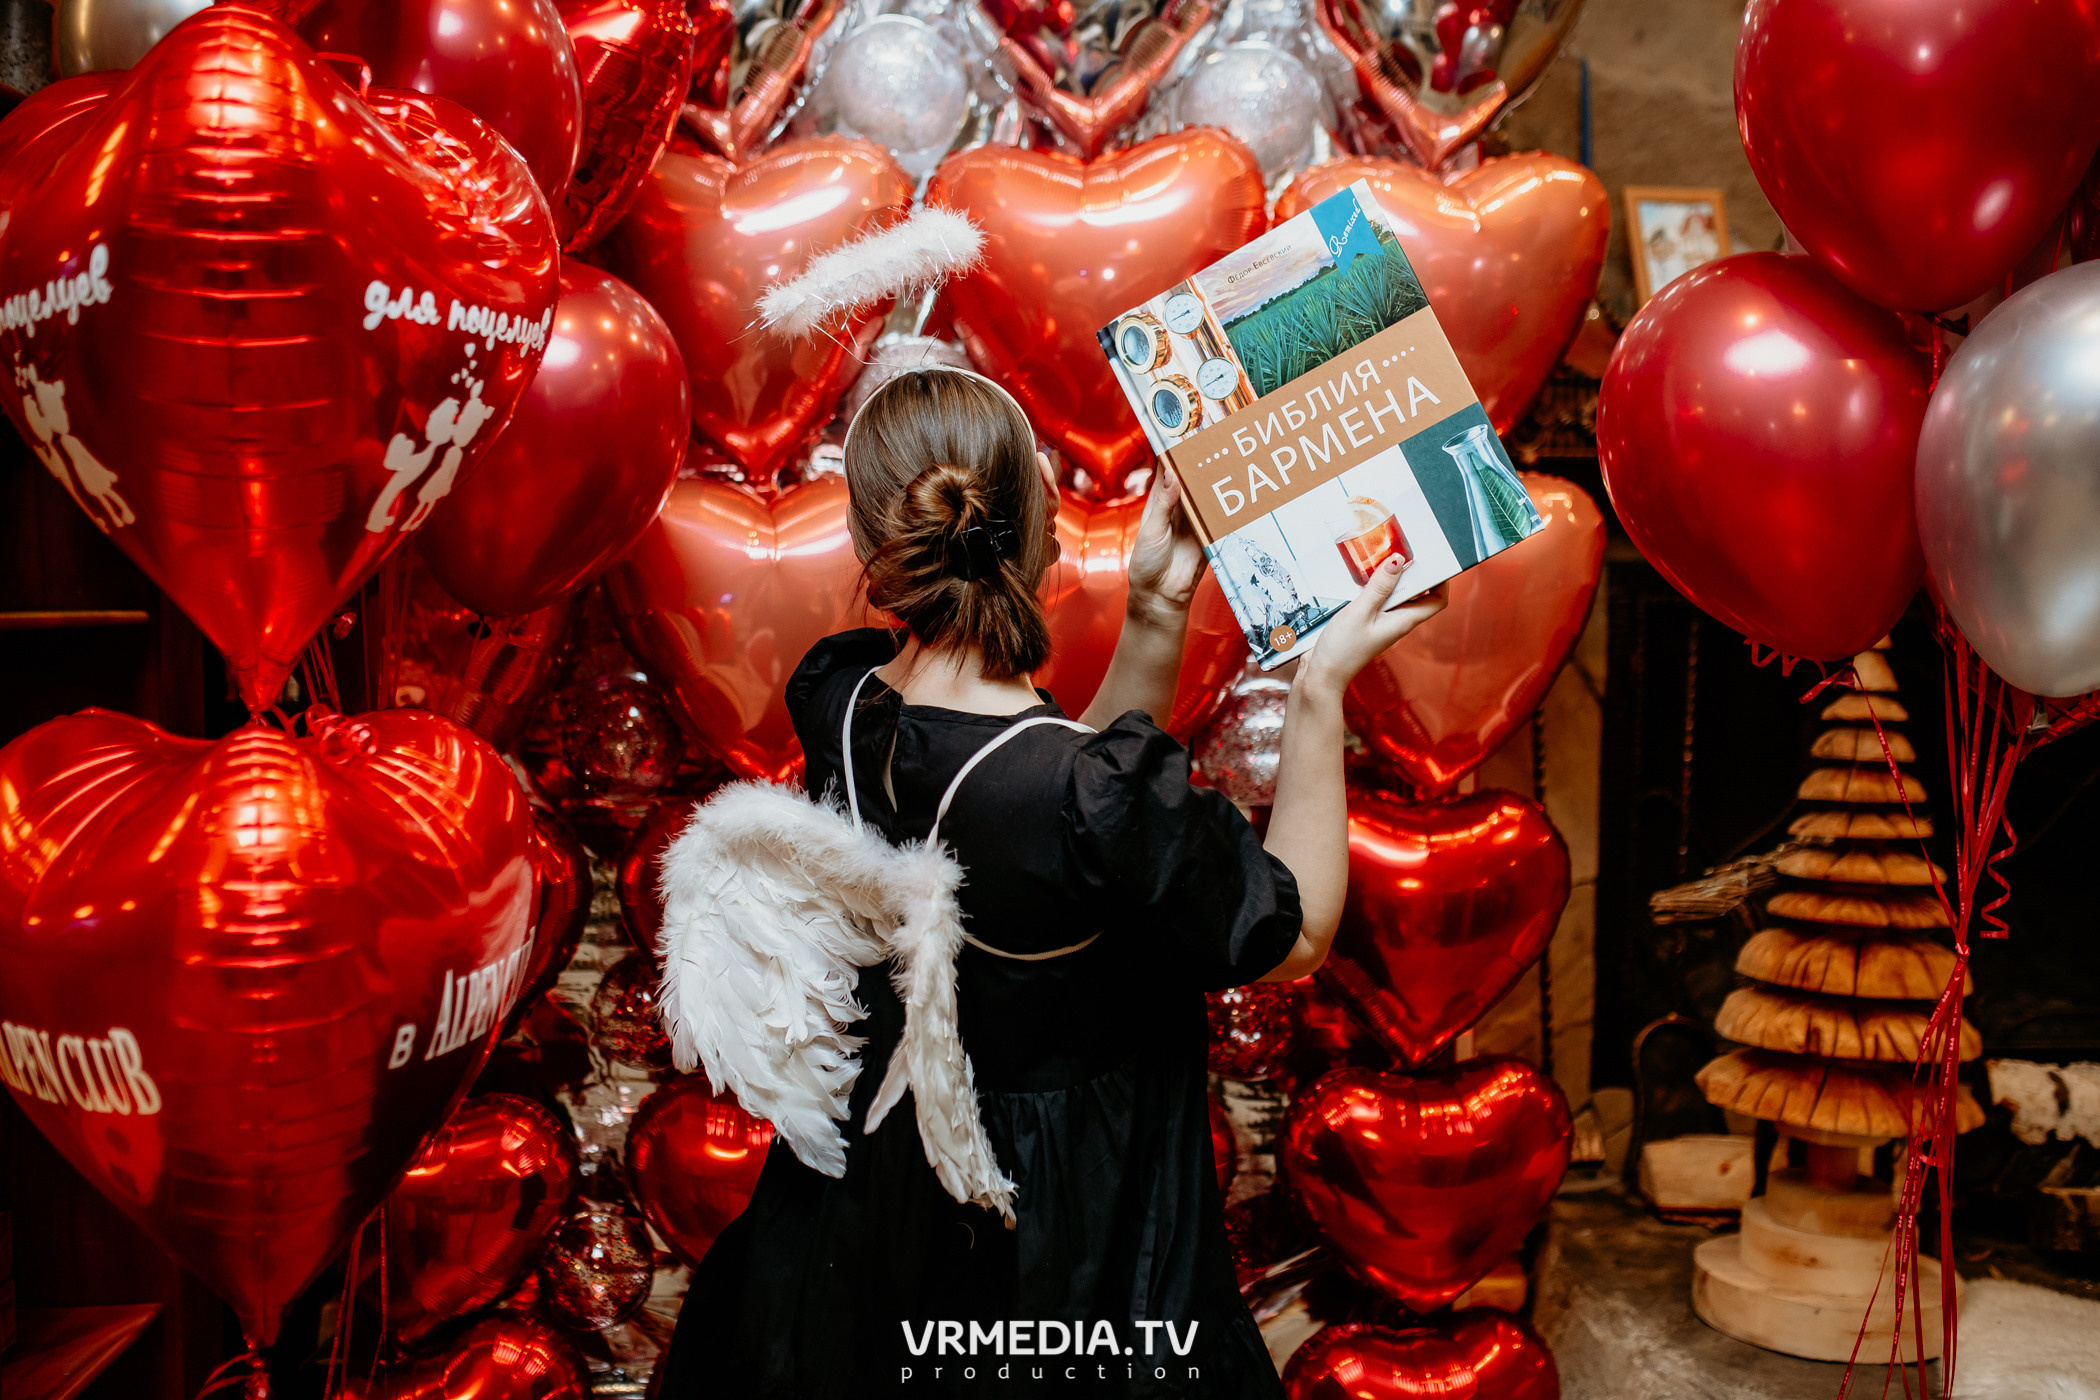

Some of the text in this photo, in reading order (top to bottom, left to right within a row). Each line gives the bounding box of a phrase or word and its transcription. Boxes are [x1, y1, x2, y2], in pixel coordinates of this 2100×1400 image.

[1329, 198, 1361, 258] Remixed
[363, 279, 554, 358] для поцелуев
[1211, 375, 1441, 517] БАРМЕНА
[1231, 358, 1382, 458] БИБЛИЯ
[1273, 631, 1293, 647] 18+
[56, 1026, 163, 1116] CLUB
